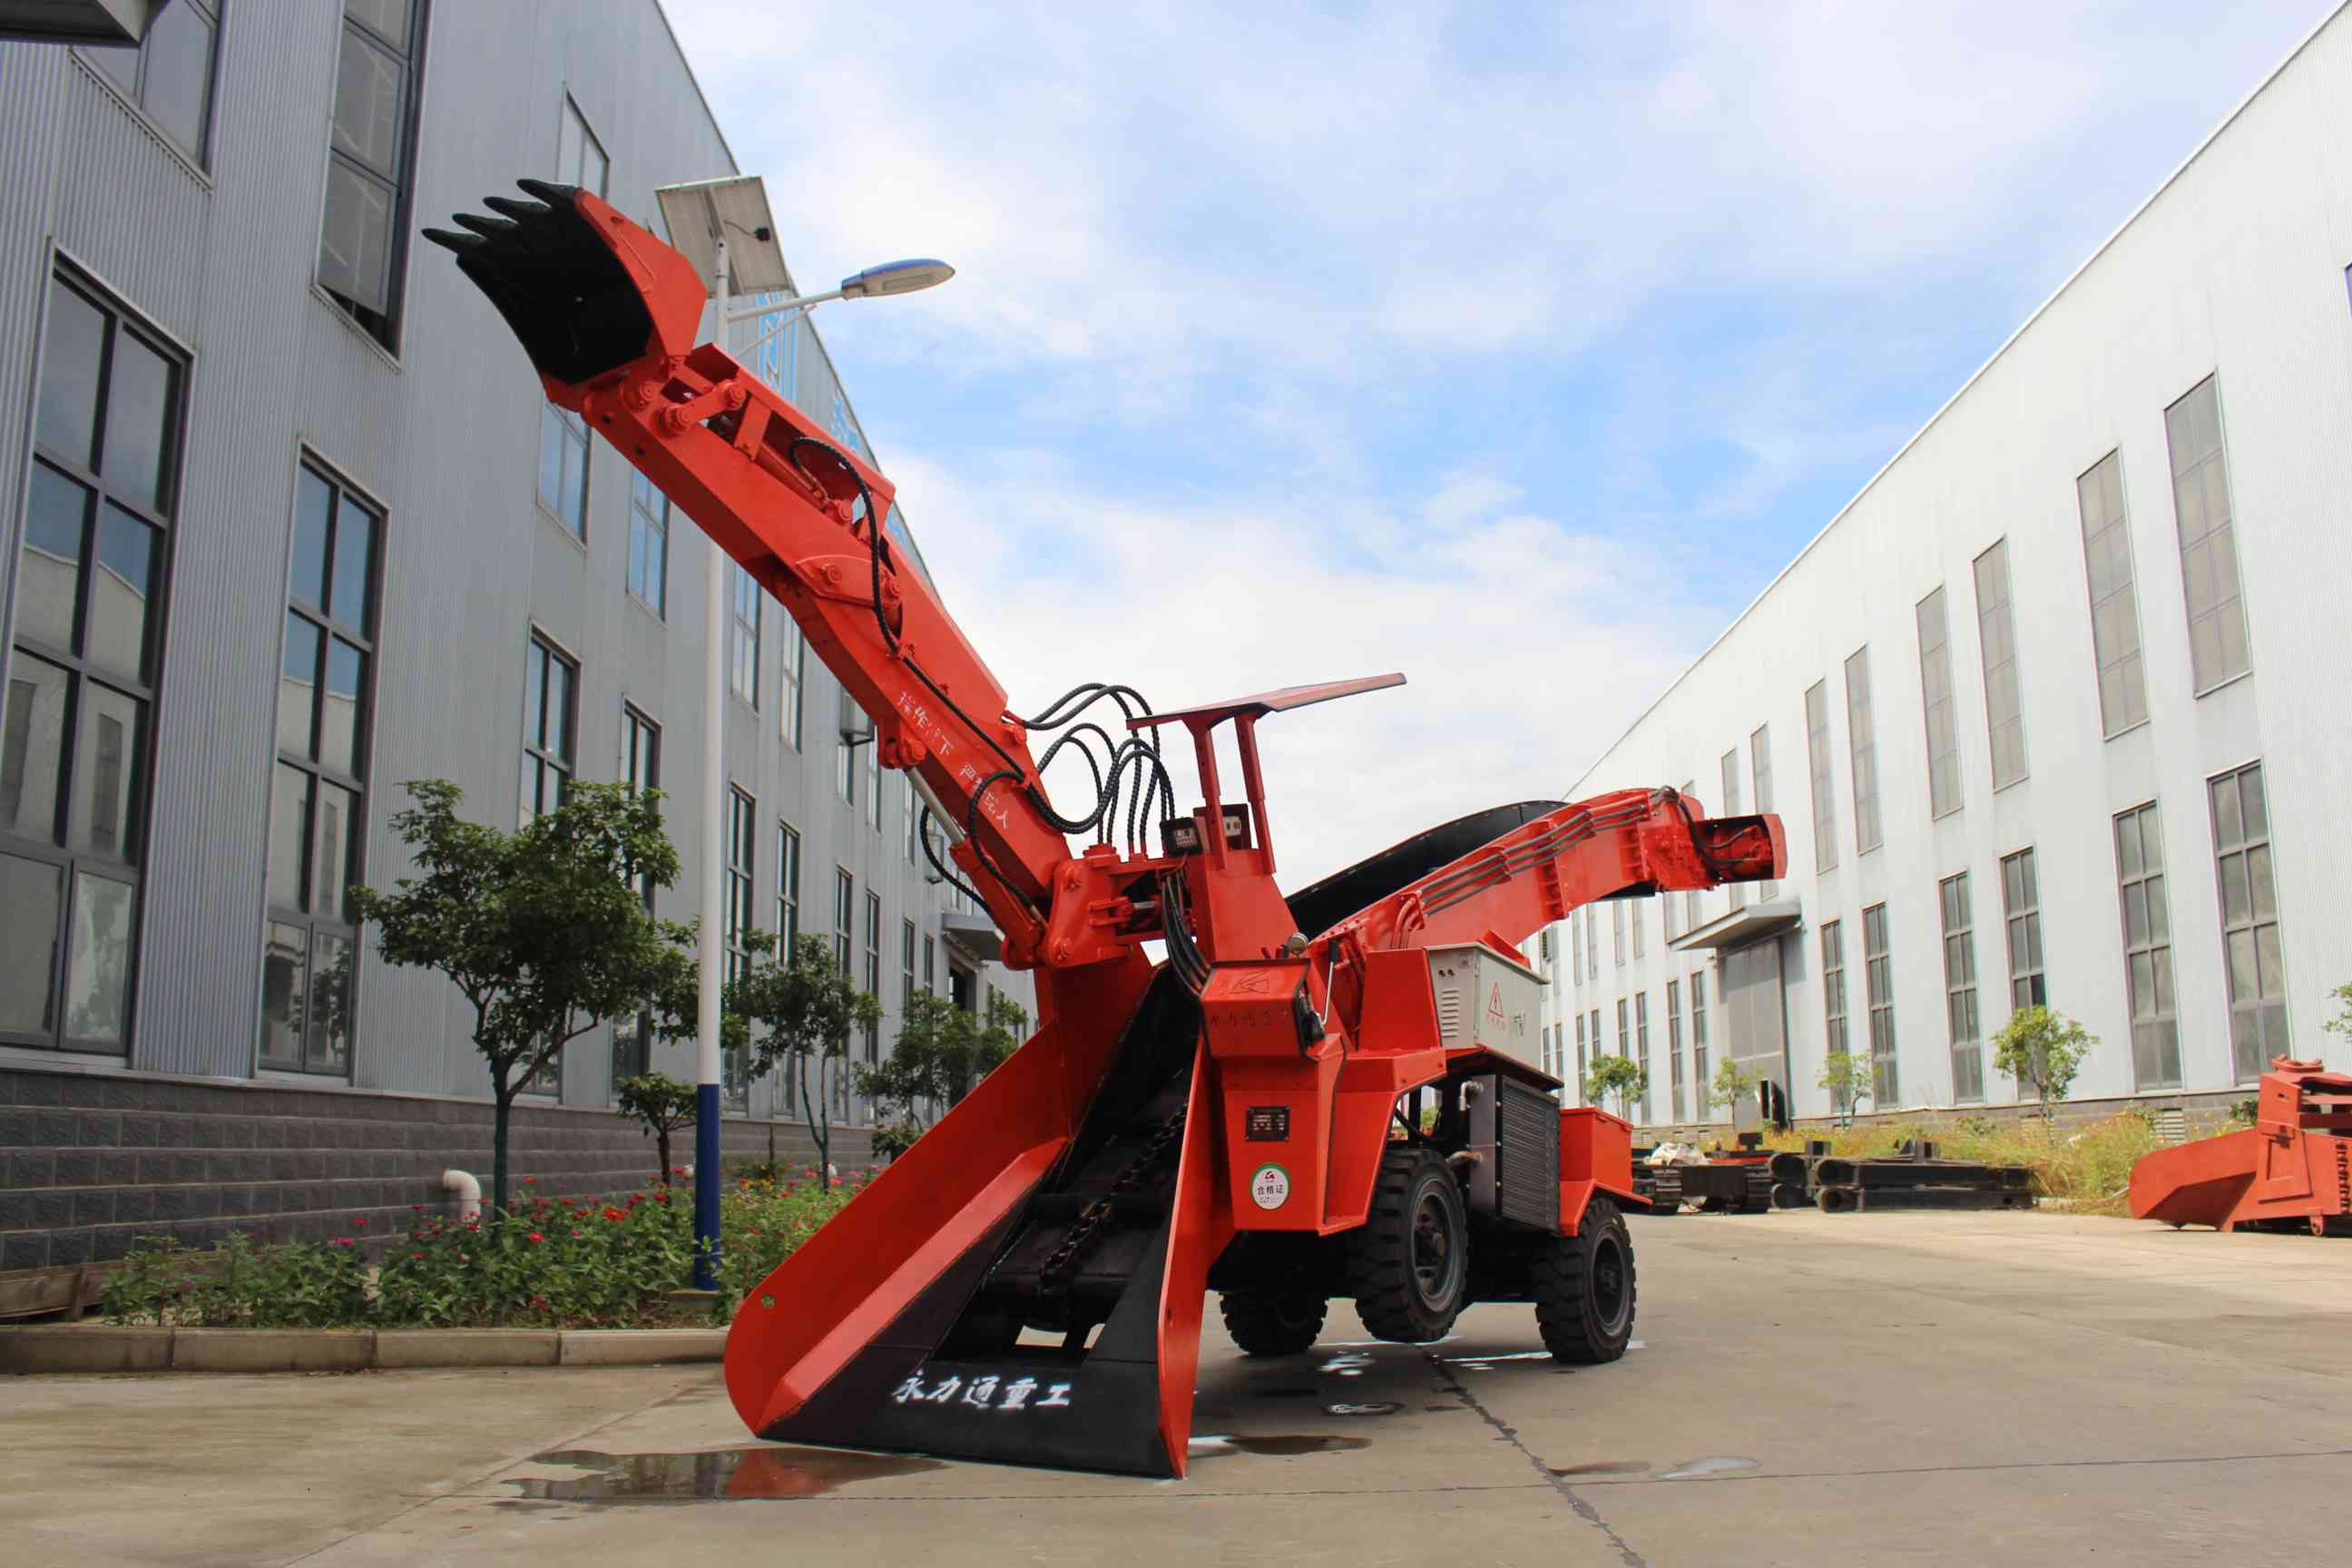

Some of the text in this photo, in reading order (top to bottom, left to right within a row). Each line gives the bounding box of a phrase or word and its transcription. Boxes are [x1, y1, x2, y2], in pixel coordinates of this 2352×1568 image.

[1257, 1184, 1284, 1195] 合格证
[890, 1368, 1072, 1409] 永力通重工
